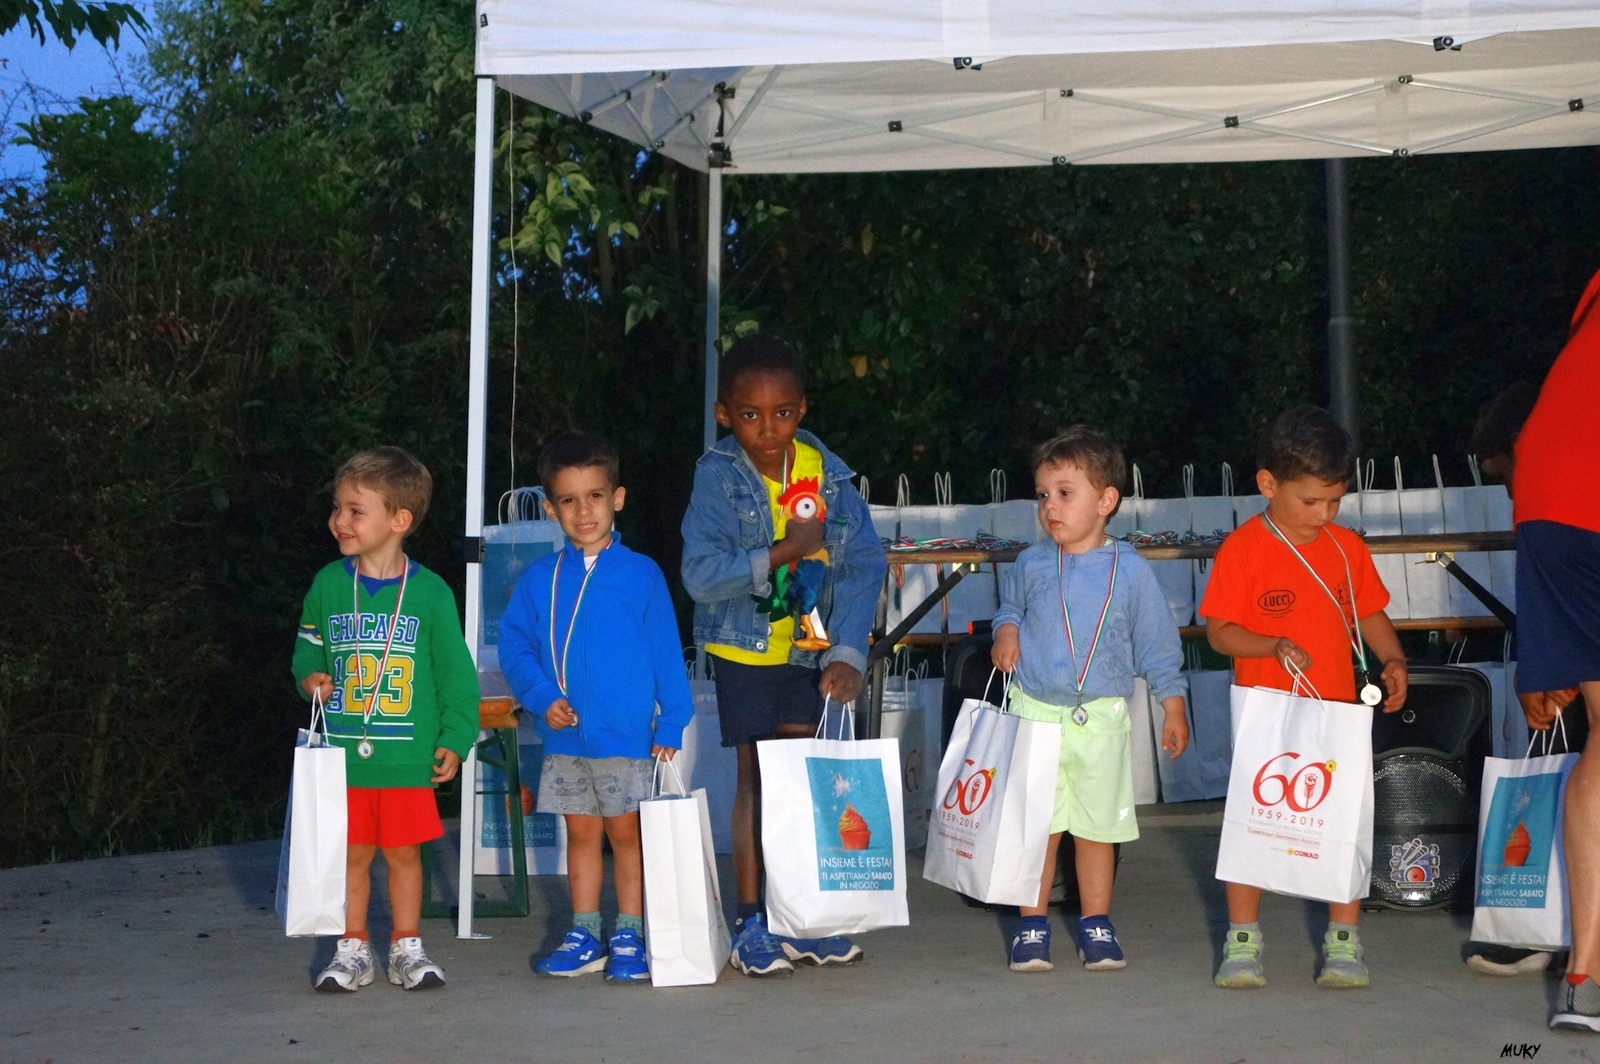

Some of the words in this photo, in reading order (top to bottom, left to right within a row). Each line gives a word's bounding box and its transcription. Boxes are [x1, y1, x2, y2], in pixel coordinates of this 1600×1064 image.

[1263, 594, 1290, 607] LUCCI
[328, 613, 419, 645] CHICAGO
[343, 653, 415, 717] 23
[943, 758, 994, 816] 60
[1252, 751, 1333, 813] 60
[938, 810, 980, 830] 1959-2019
[1250, 806, 1325, 828] 1959-2019
[820, 857, 856, 868] INSIEME
[858, 855, 864, 867] È
[866, 856, 892, 868] FESTA!
[1294, 850, 1320, 860] CONAD
[821, 872, 828, 881] TI
[830, 872, 871, 881] ASPETTIAMO
[871, 872, 893, 880] SABATO
[1510, 872, 1516, 884] È
[1518, 874, 1546, 885] FESTA!
[840, 881, 848, 890] IN
[849, 881, 880, 890] NEGOZIO
[1519, 889, 1544, 898] SABATO
[1495, 899, 1527, 907] NEGOZIO
